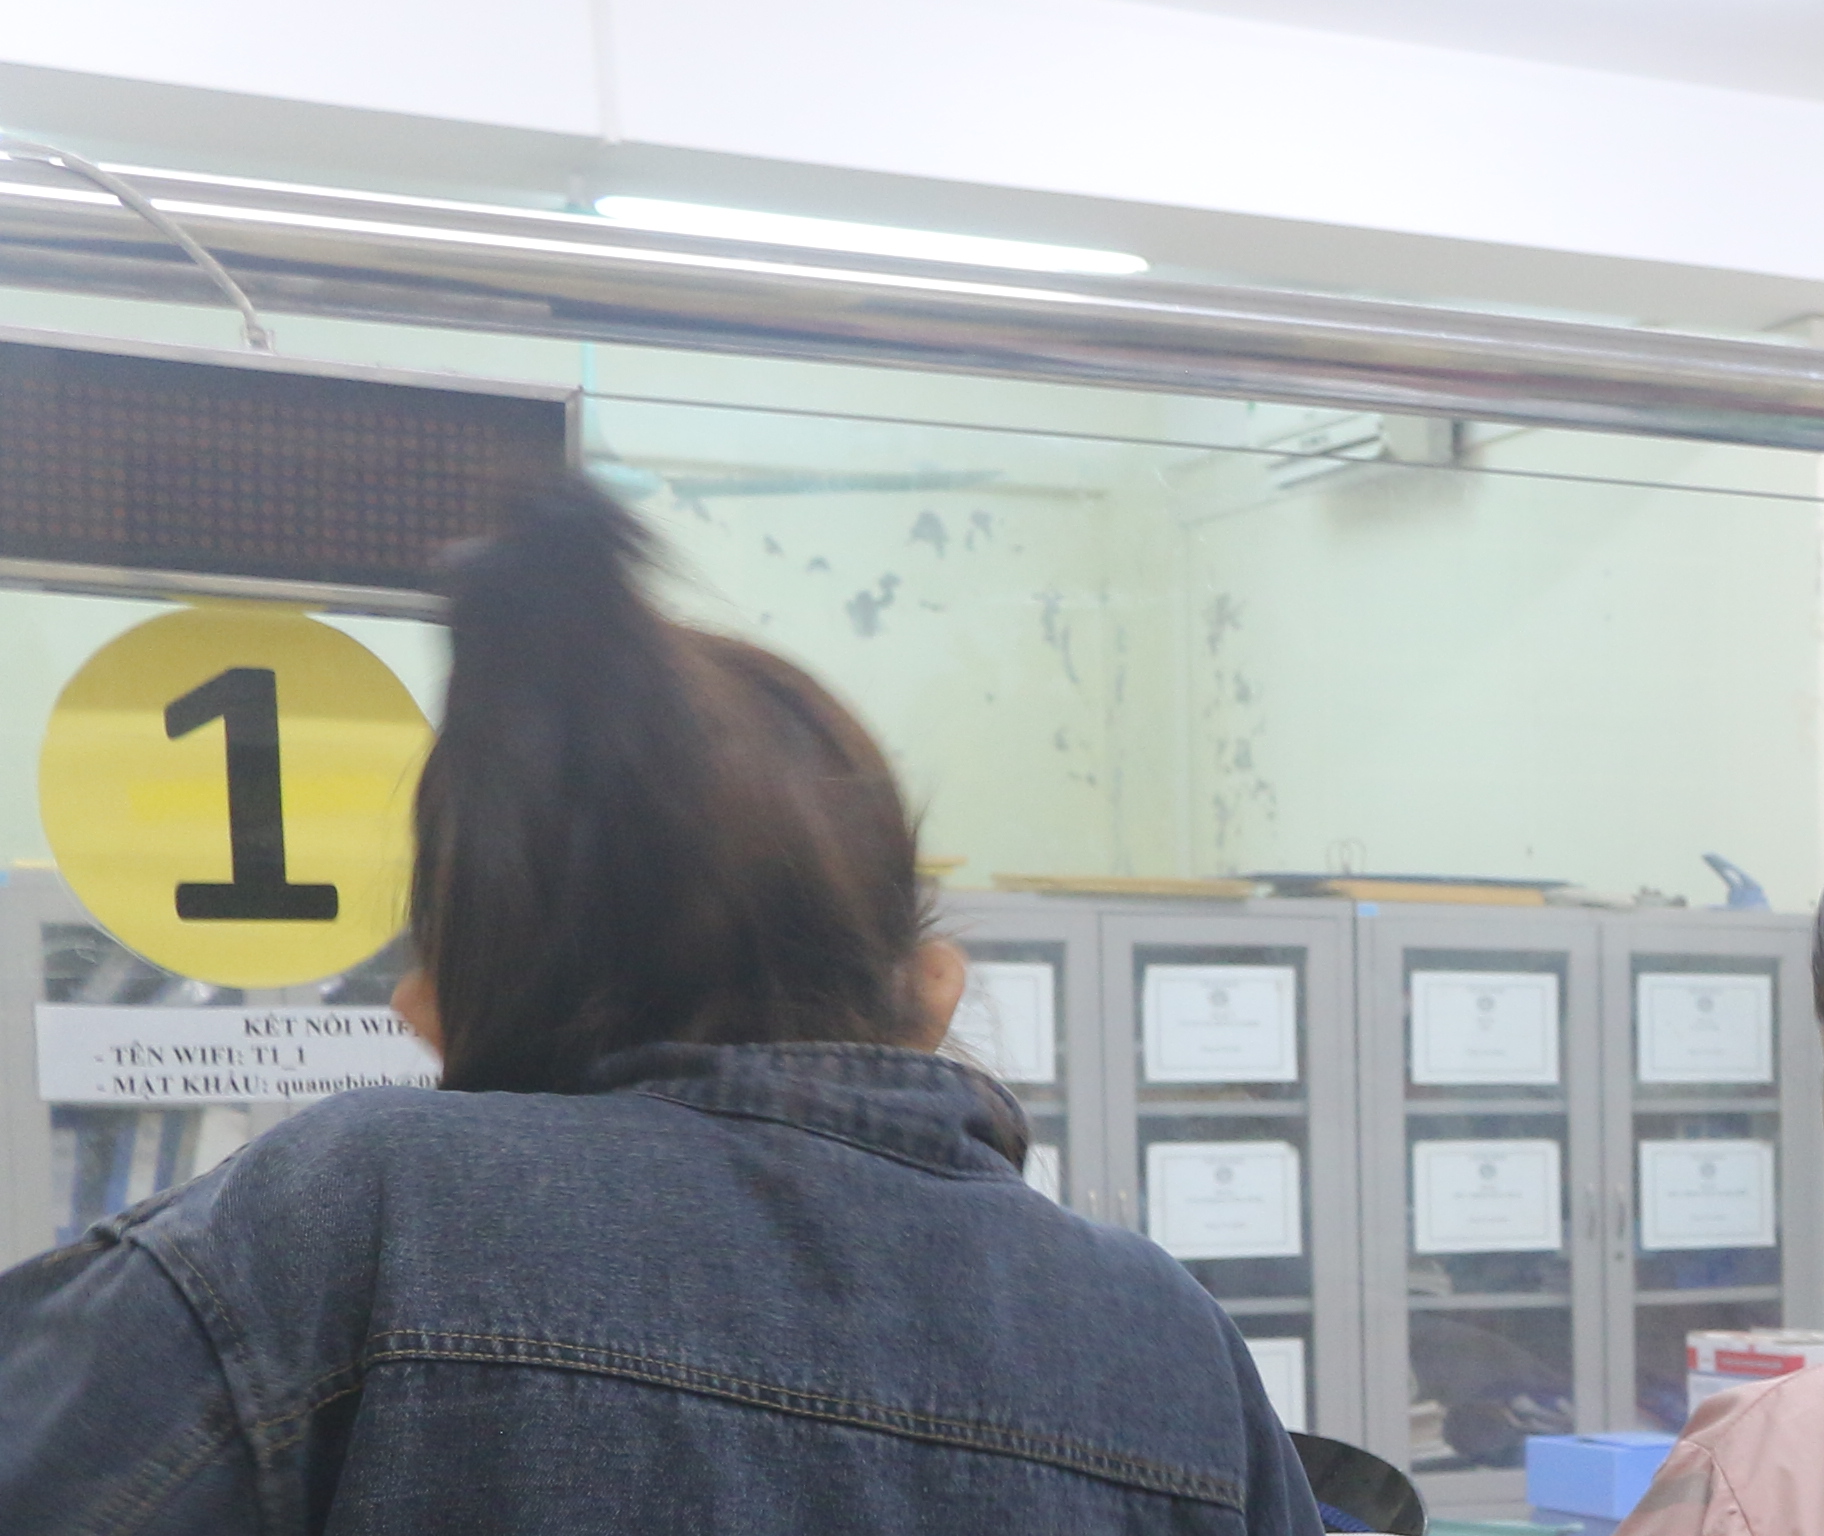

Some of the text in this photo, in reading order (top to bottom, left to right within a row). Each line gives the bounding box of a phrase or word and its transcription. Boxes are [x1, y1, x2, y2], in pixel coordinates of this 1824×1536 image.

[165, 667, 338, 920] 1
[360, 1017, 419, 1037] WIF
[110, 1040, 164, 1066] TÊN
[172, 1046, 244, 1066] WIFI:
